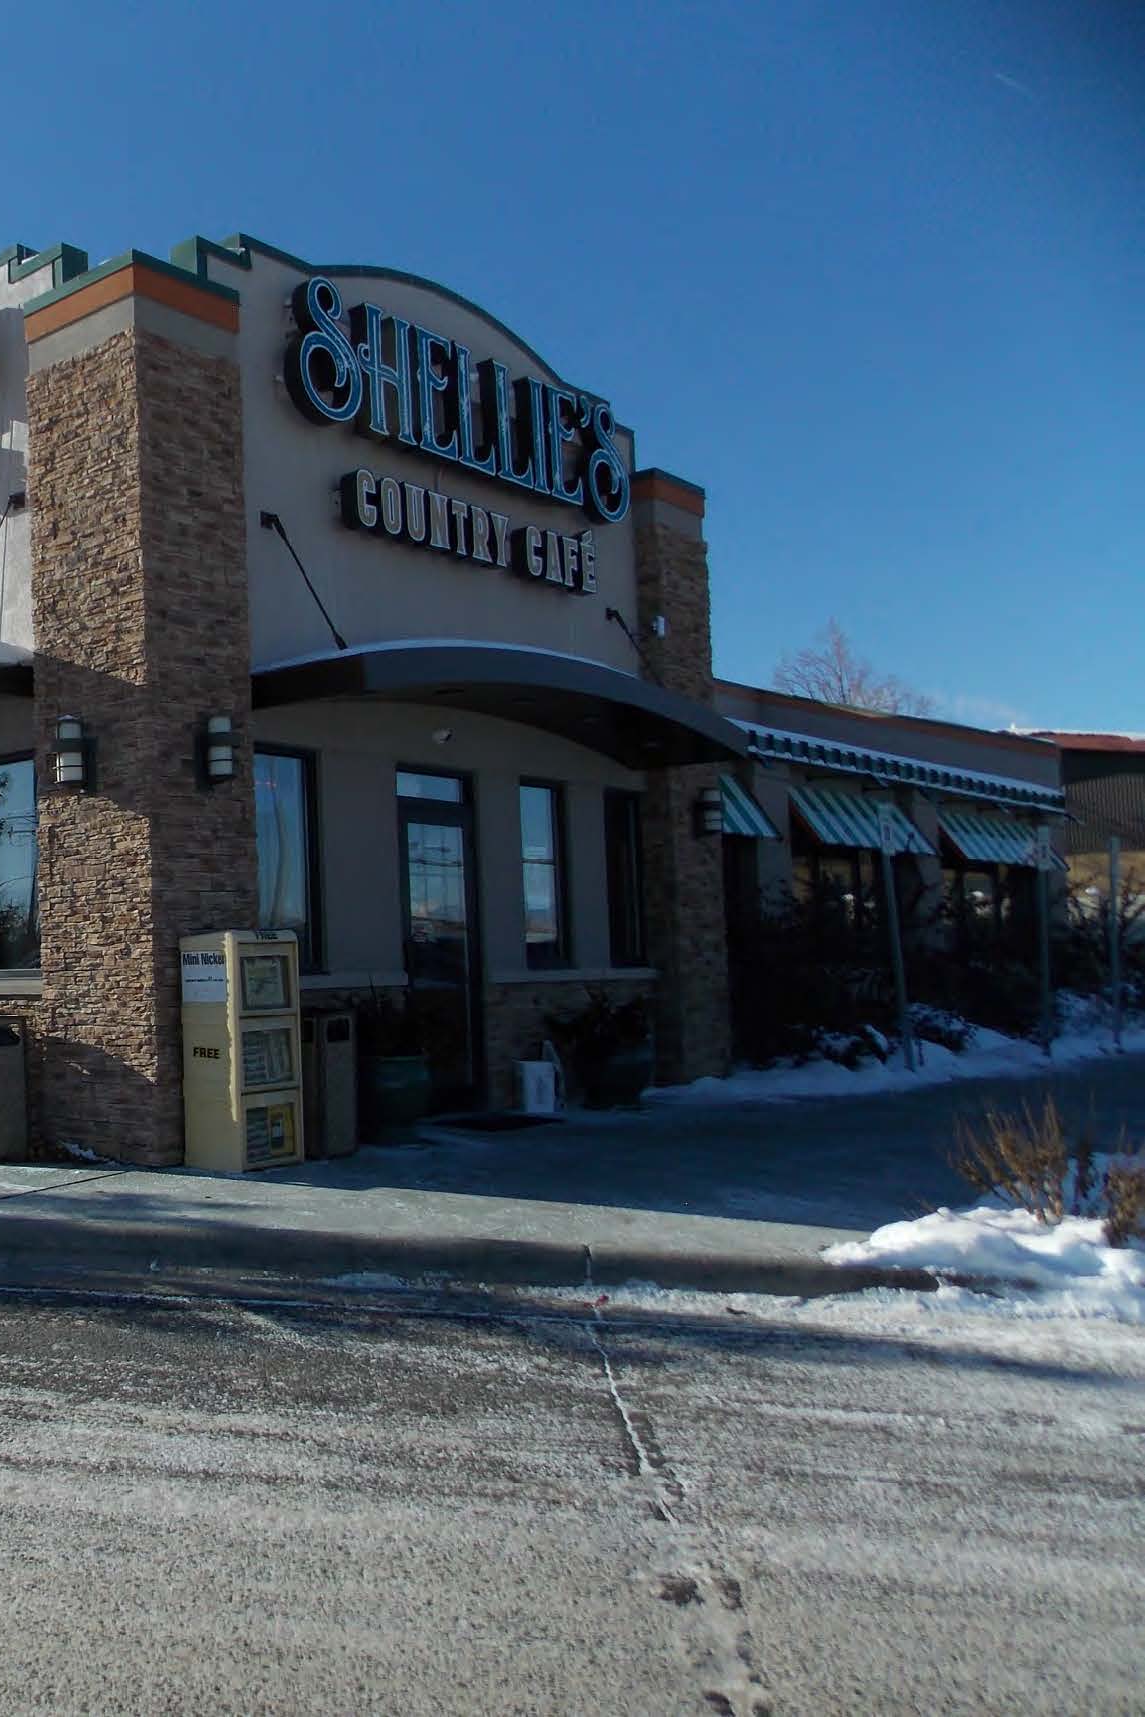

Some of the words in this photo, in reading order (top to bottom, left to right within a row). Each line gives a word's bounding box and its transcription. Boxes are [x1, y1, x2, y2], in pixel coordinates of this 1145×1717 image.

[300, 276, 631, 523] SHELLIE'S
[356, 469, 511, 567] COUNTRY
[525, 529, 599, 594] CAFÉ
[182, 952, 200, 966] Mini
[193, 1046, 221, 1060] FREE
